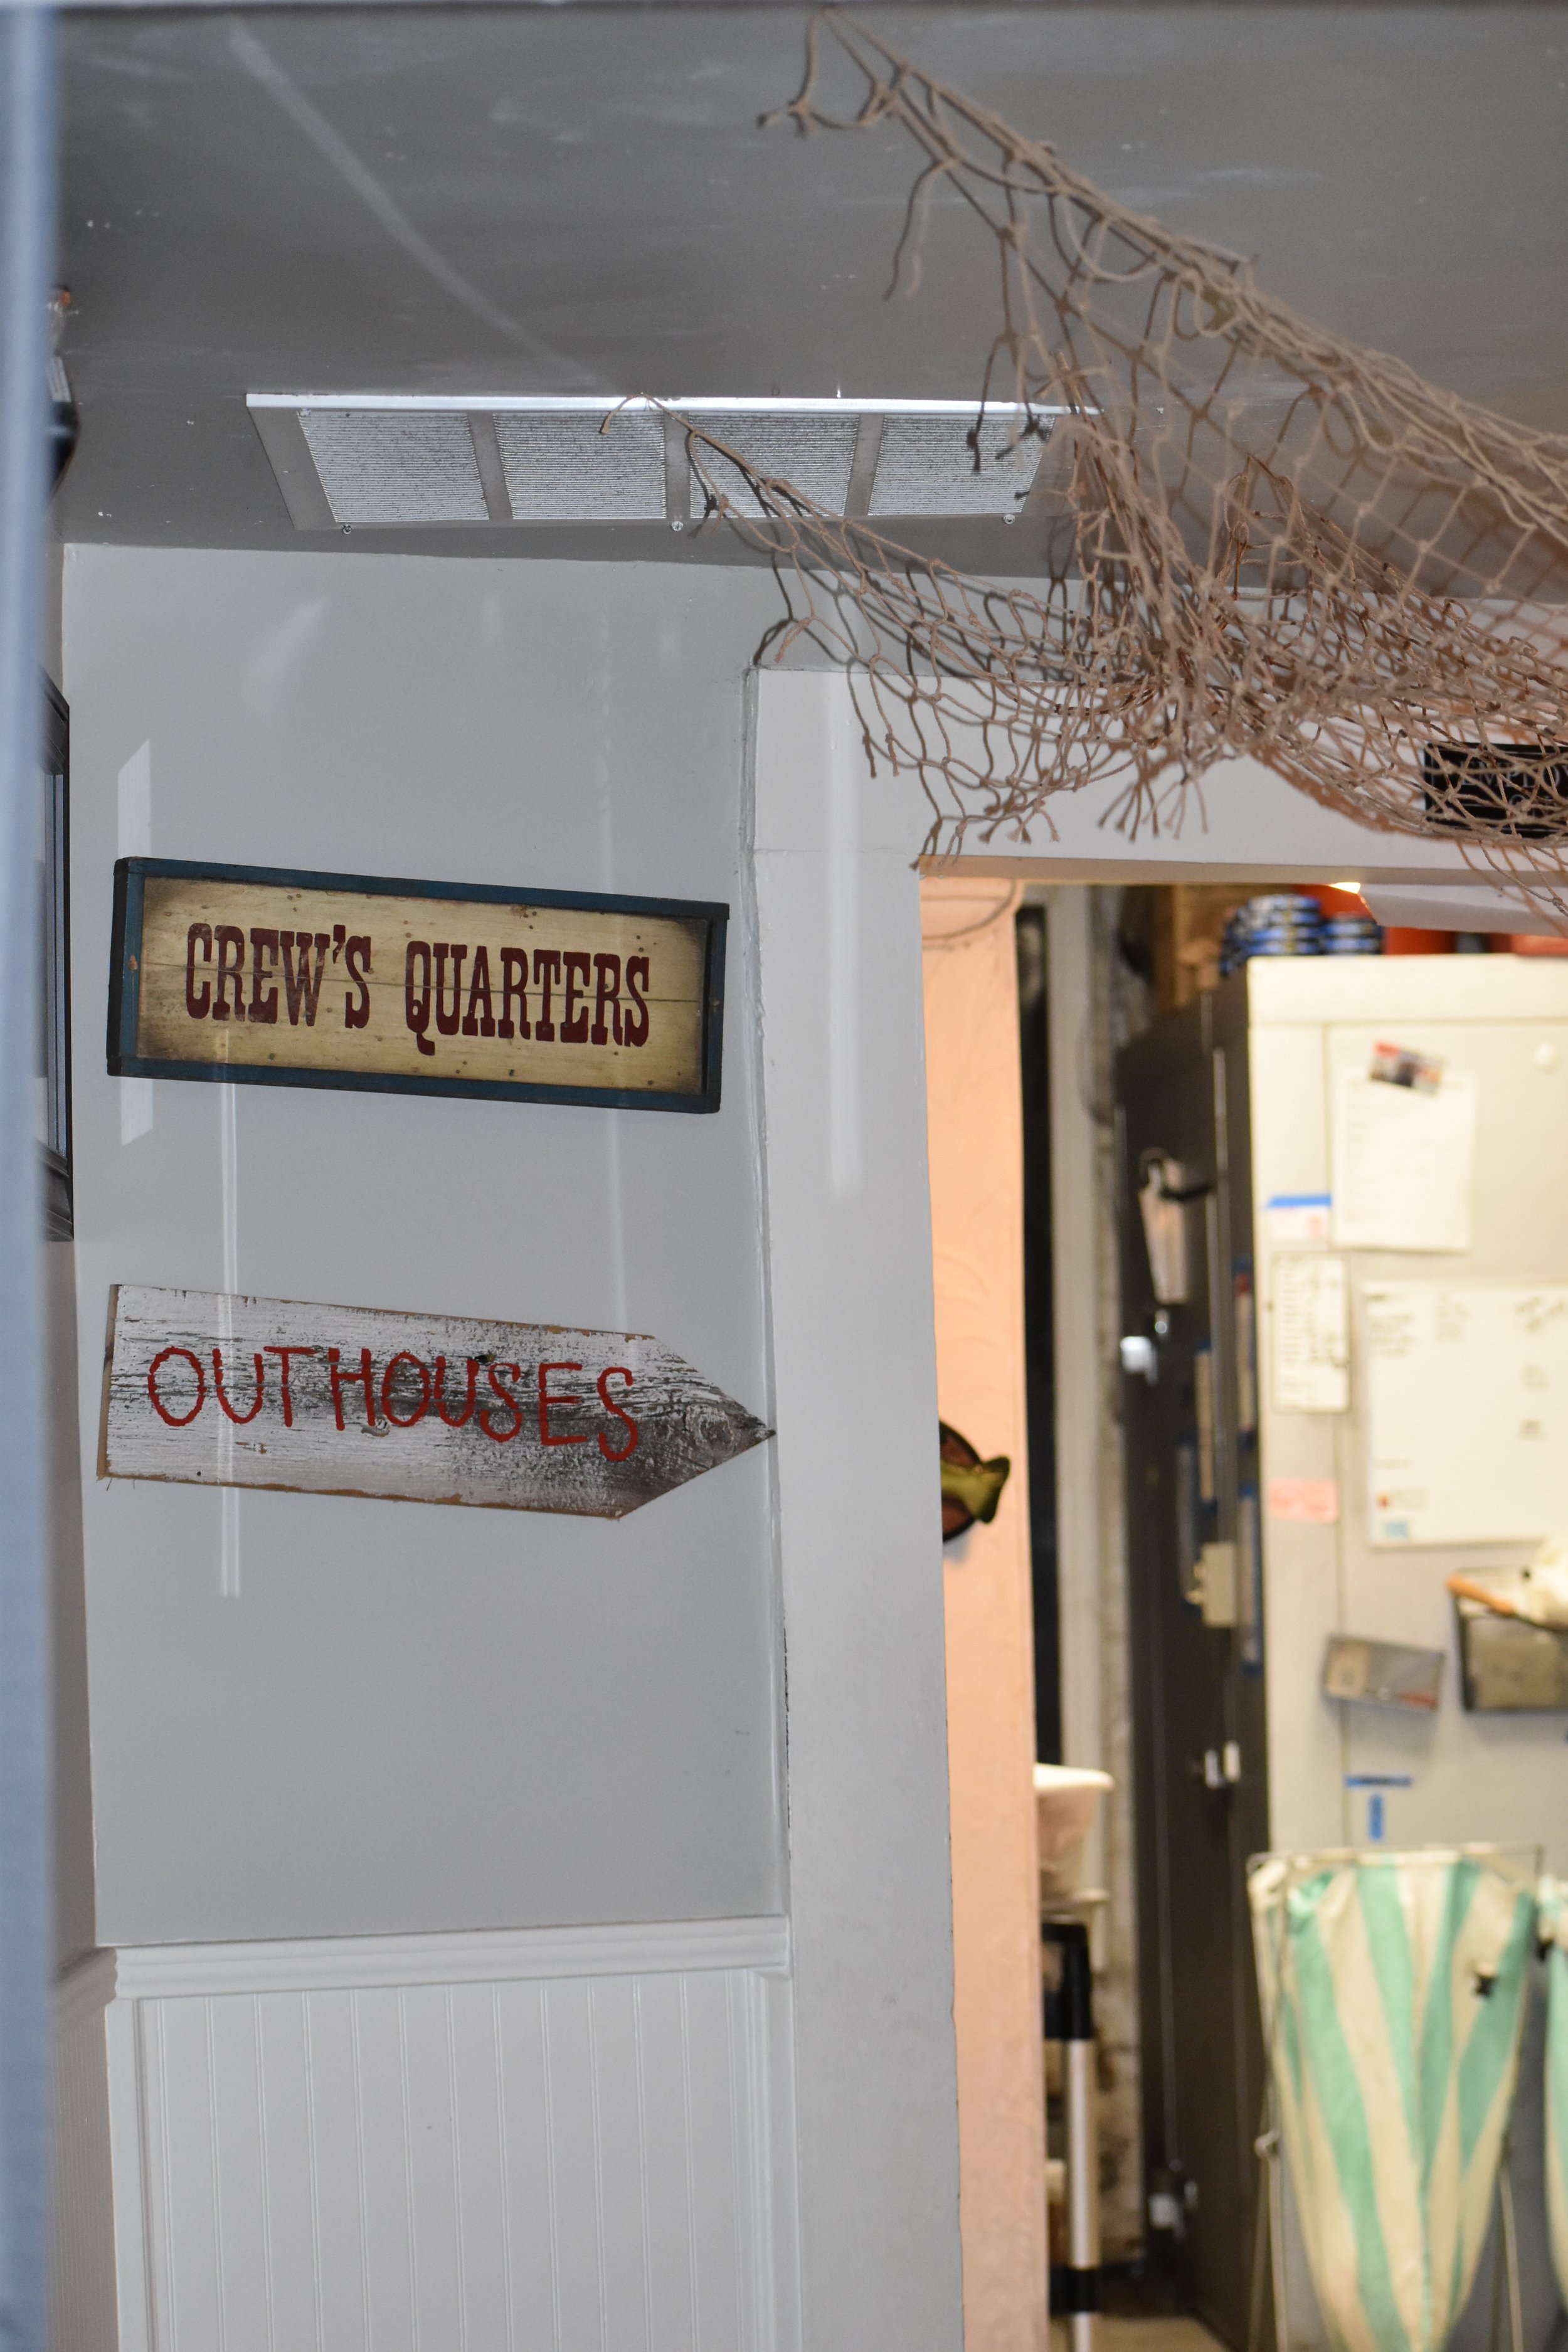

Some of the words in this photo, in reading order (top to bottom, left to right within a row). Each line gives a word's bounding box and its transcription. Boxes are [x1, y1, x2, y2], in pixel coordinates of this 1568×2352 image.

[184, 923, 371, 1029] CREW'S
[405, 940, 650, 1056] QUARTERS
[147, 1346, 638, 1461] OUTHOUSES
